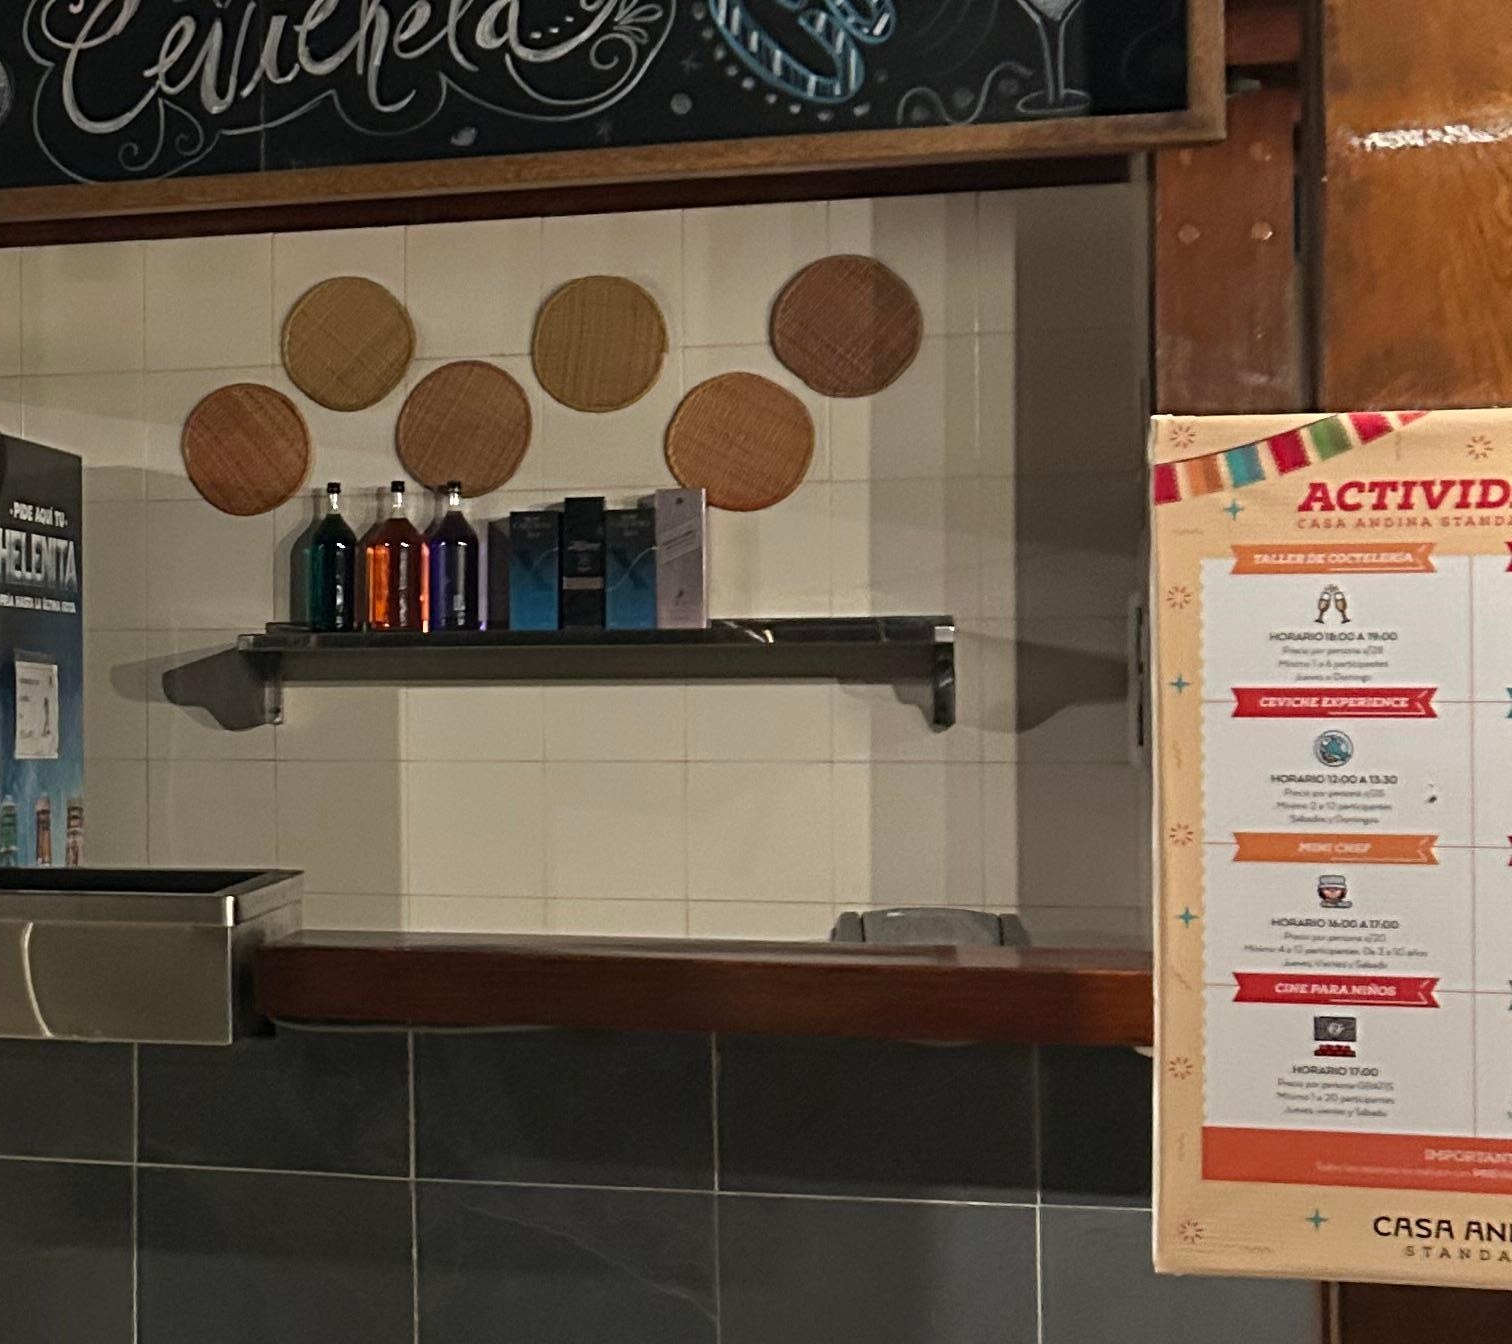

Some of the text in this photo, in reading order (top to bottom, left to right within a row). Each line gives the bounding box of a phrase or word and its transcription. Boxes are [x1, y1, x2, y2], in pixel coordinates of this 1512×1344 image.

[1297, 478, 1512, 513] ACTIVID
[13, 501, 34, 522] PIDE
[1297, 518, 1346, 529] CASA
[1355, 516, 1433, 528] ANDINA
[1254, 553, 1304, 564] TALLER
[1269, 632, 1324, 641] HORARIO
[1356, 632, 1365, 641] A
[1259, 697, 1410, 707] CEVICHE EXPERIENCE
[1270, 775, 1325, 784] HORARIO
[1359, 775, 1367, 784] A
[1271, 918, 1325, 928] HORARIO
[1359, 919, 1368, 929] A
[1275, 982, 1397, 995] CINE PARA NIÑOS
[1292, 1066, 1348, 1075] HORARIO
[1373, 1216, 1512, 1242] CASA AN
